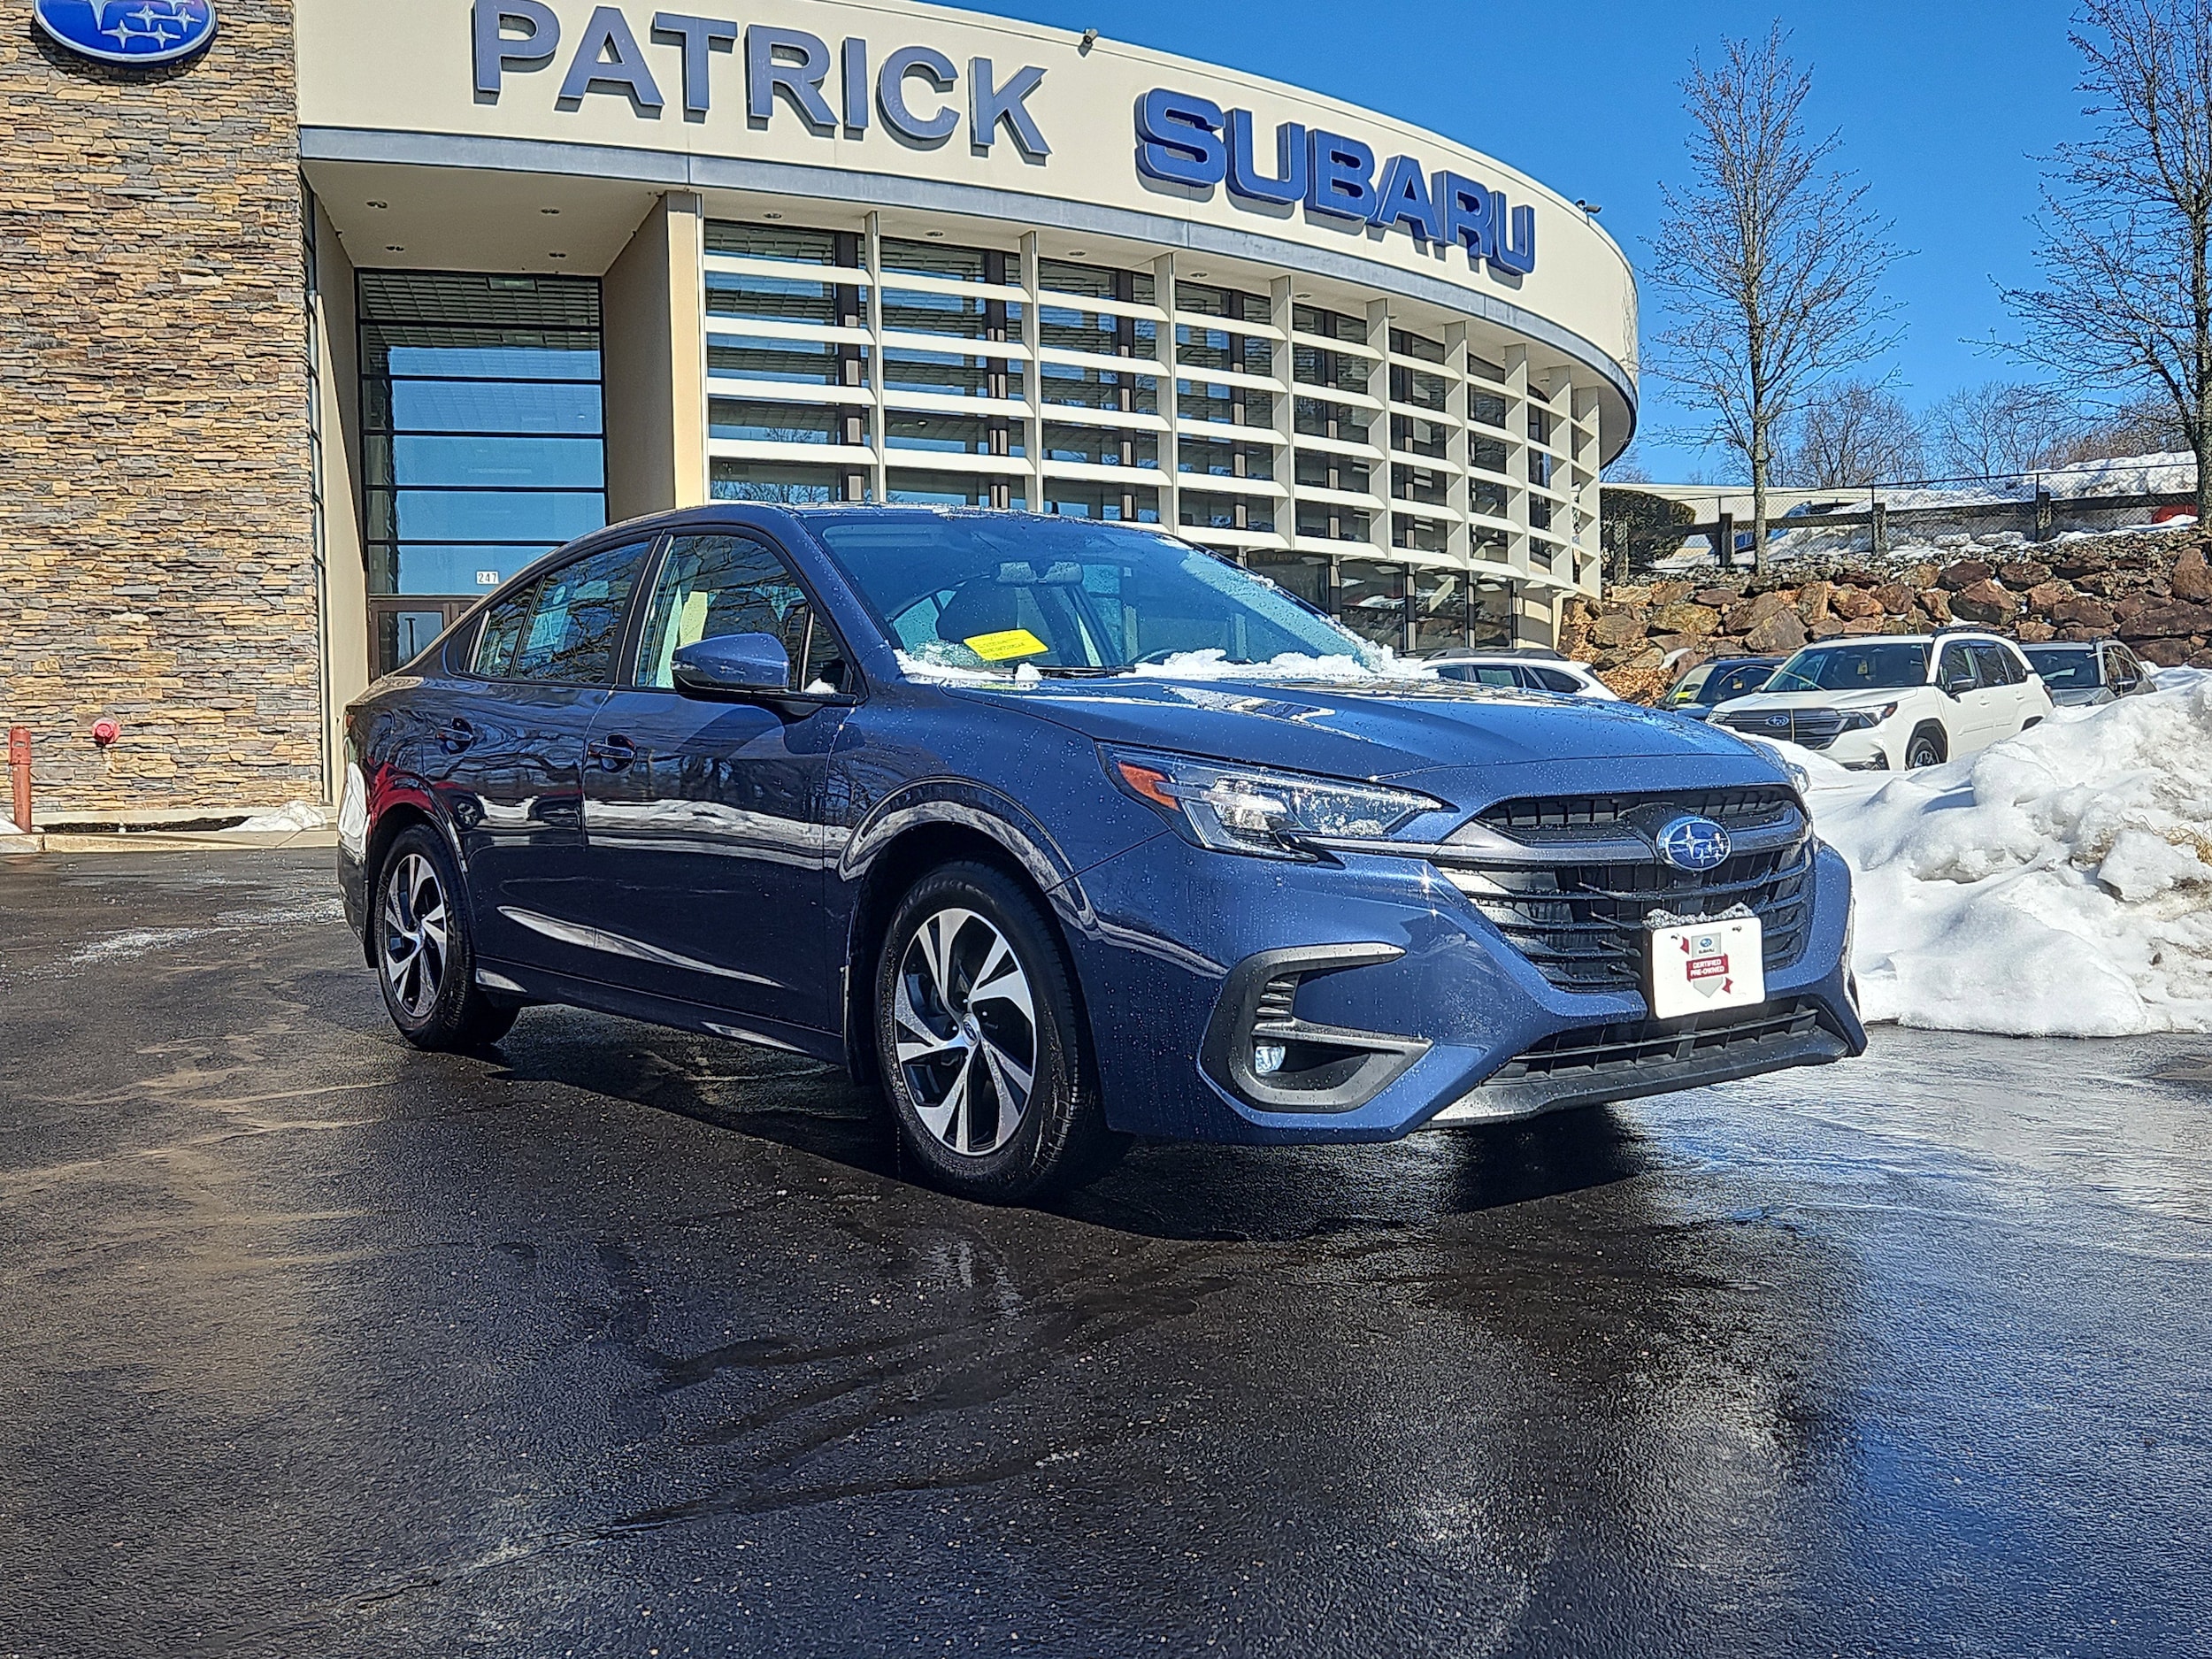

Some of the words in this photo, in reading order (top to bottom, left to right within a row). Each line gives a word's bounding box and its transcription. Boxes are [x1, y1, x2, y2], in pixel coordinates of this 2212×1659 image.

[472, 0, 1052, 162] PATRICK
[1134, 87, 1536, 277] SUBARU
[478, 572, 496, 583] 247
[1692, 958, 1722, 969] CERTIFIED
[1690, 965, 1725, 977] PRE-OWNED
